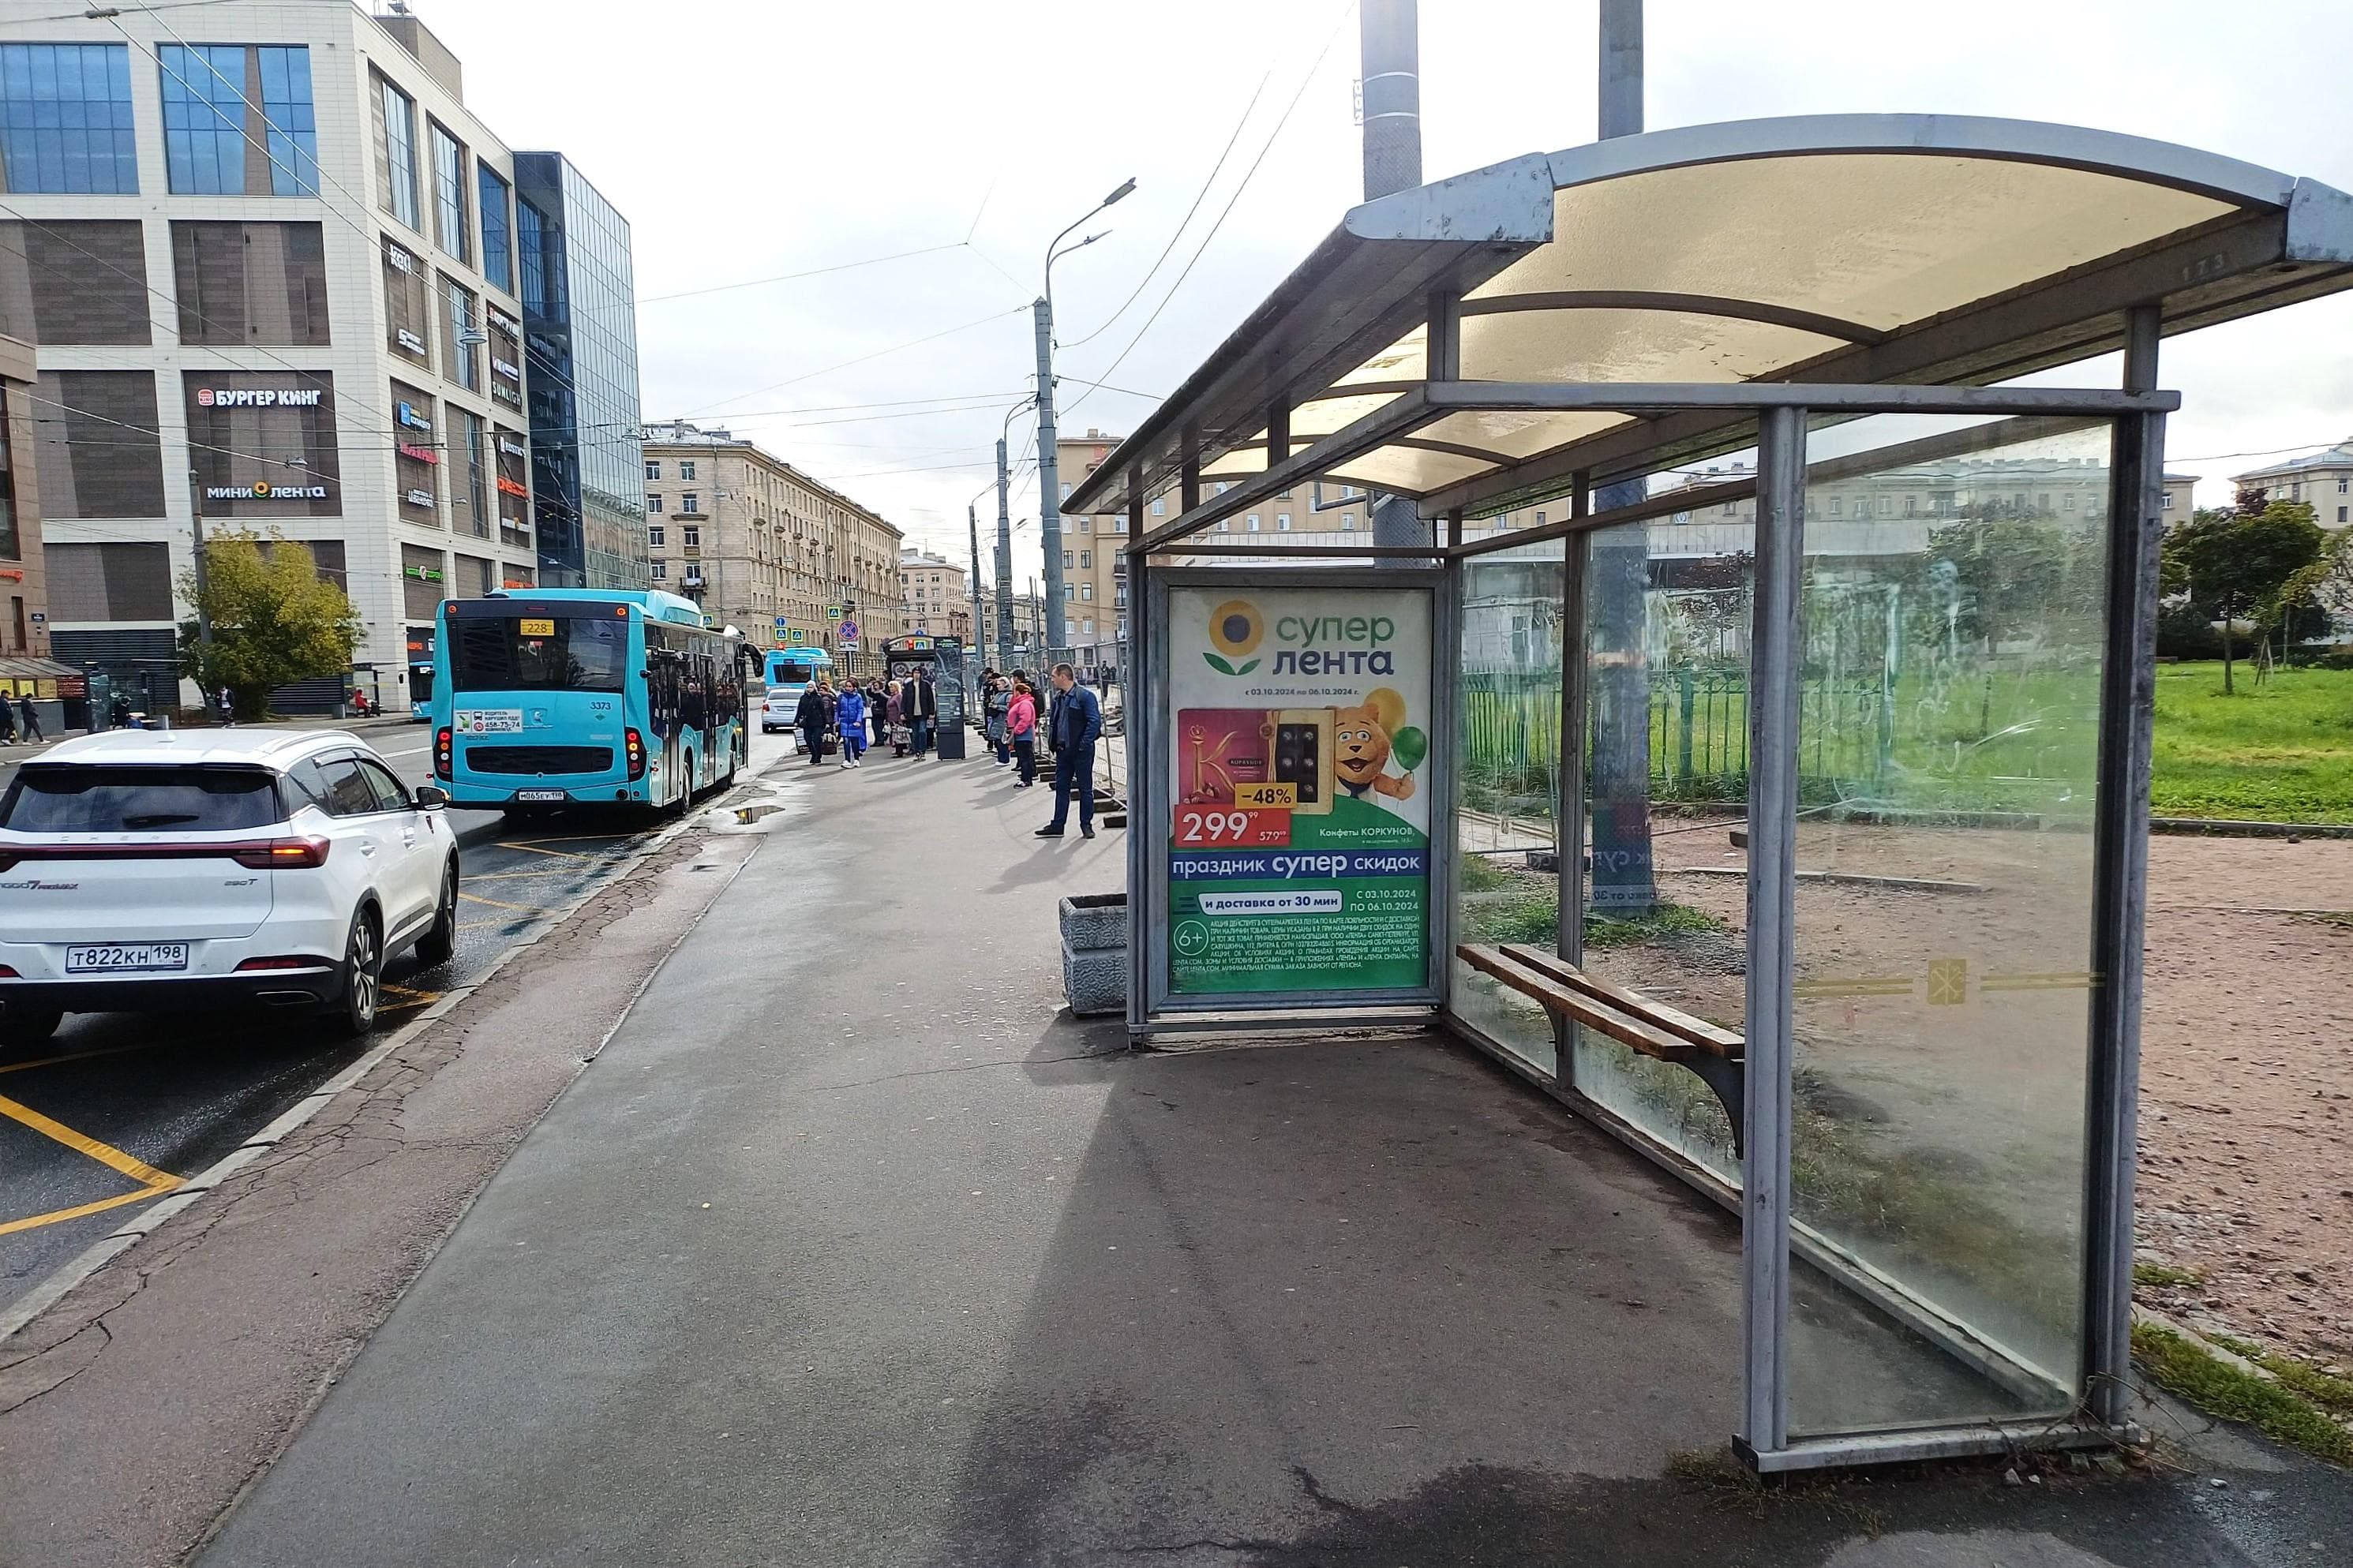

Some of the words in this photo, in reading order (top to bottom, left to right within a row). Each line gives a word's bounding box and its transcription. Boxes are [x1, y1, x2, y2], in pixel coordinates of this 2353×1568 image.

[215, 390, 276, 406] БУРГЕР
[278, 390, 321, 406] КИНГ
[207, 487, 253, 498] мини
[269, 486, 327, 498] лента
[527, 623, 548, 633] 228
[1276, 616, 1395, 648] супер
[1272, 650, 1395, 675] лента
[590, 702, 612, 710] 3373
[1242, 788, 1292, 805] -48%
[1182, 812, 1248, 841] 299
[1320, 829, 1359, 838] Конфеты
[1361, 827, 1415, 837] КОРКУНОВ,
[1259, 831, 1280, 841] 579
[1173, 859, 1265, 879] праздник
[1272, 855, 1347, 879] супер
[1354, 855, 1420, 872] скидок
[1365, 890, 1417, 899] 03.10.2024
[1216, 898, 1276, 909] доставка
[1295, 896, 1311, 906] 30
[1313, 897, 1338, 906] мин
[1367, 902, 1419, 911] 06.10.2024
[1178, 930, 1203, 946] 6+
[74, 949, 148, 966] Т822КН
[153, 946, 181, 959] 198
